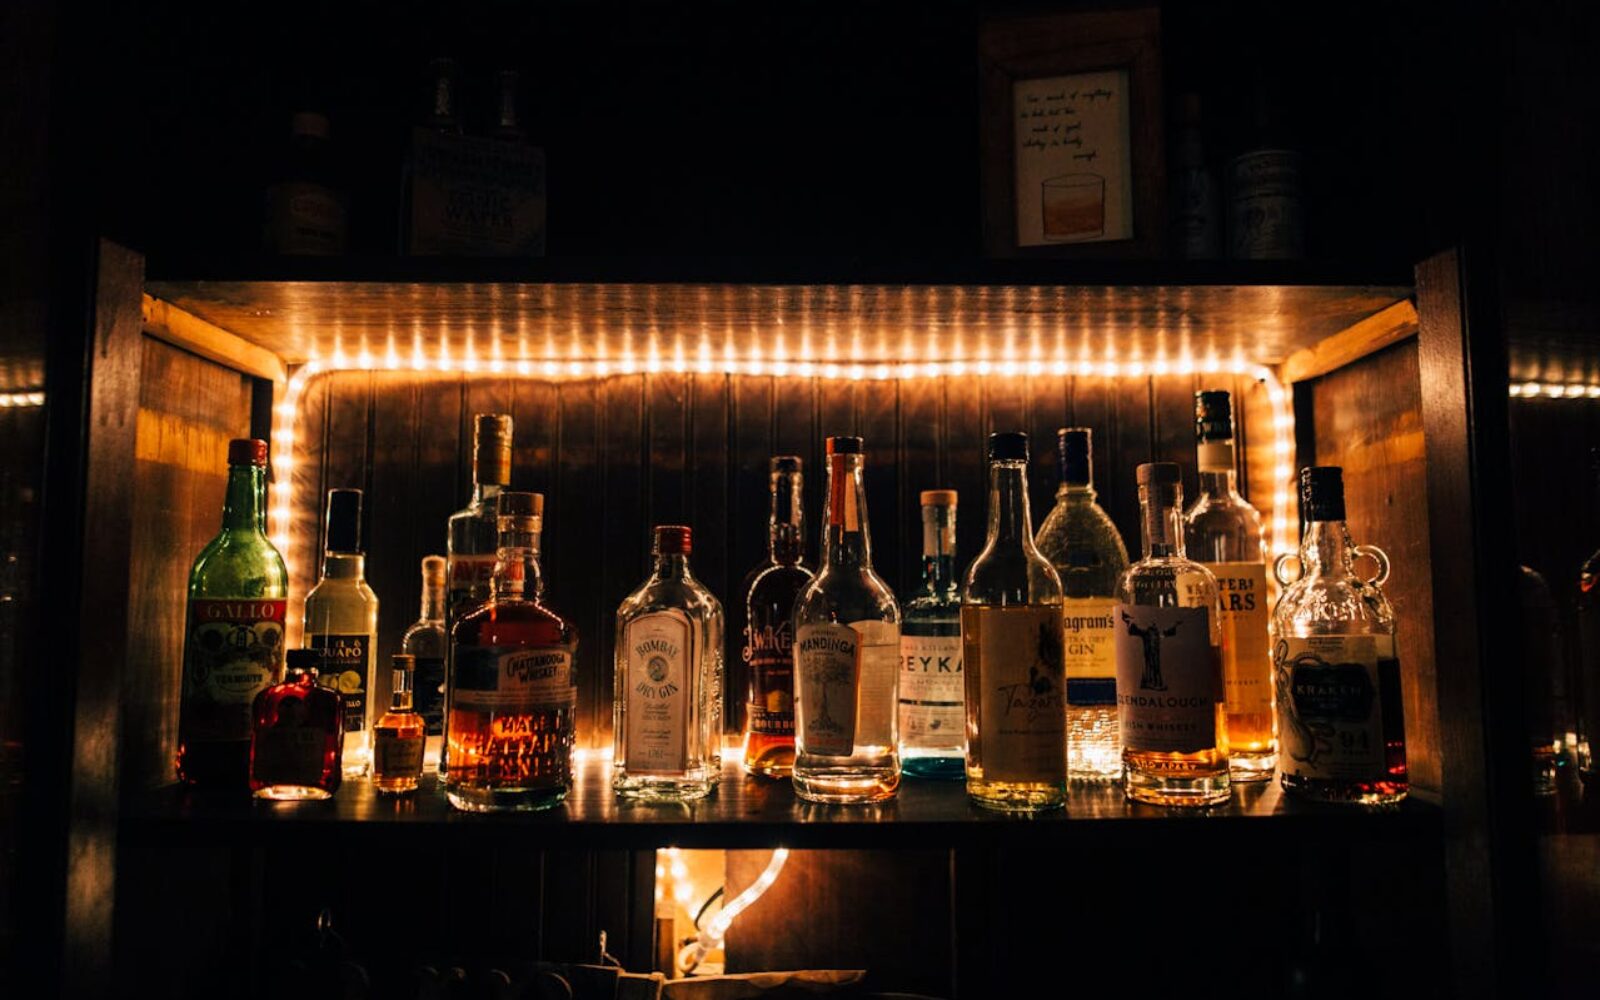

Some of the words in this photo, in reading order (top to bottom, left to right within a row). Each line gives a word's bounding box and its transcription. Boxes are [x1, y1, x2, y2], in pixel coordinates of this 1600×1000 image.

[207, 603, 275, 619] GALLO
[1064, 613, 1114, 634] agram's
[635, 639, 679, 660] BOMBAY
[799, 637, 856, 657] MANDINGA
[1068, 644, 1095, 656] GIN
[507, 654, 565, 677] CHATTANOOGA
[519, 666, 558, 683] WHISKEY
[636, 681, 656, 700] DRY
[658, 683, 679, 699] GIN
[1296, 684, 1361, 697] KRAKEN
